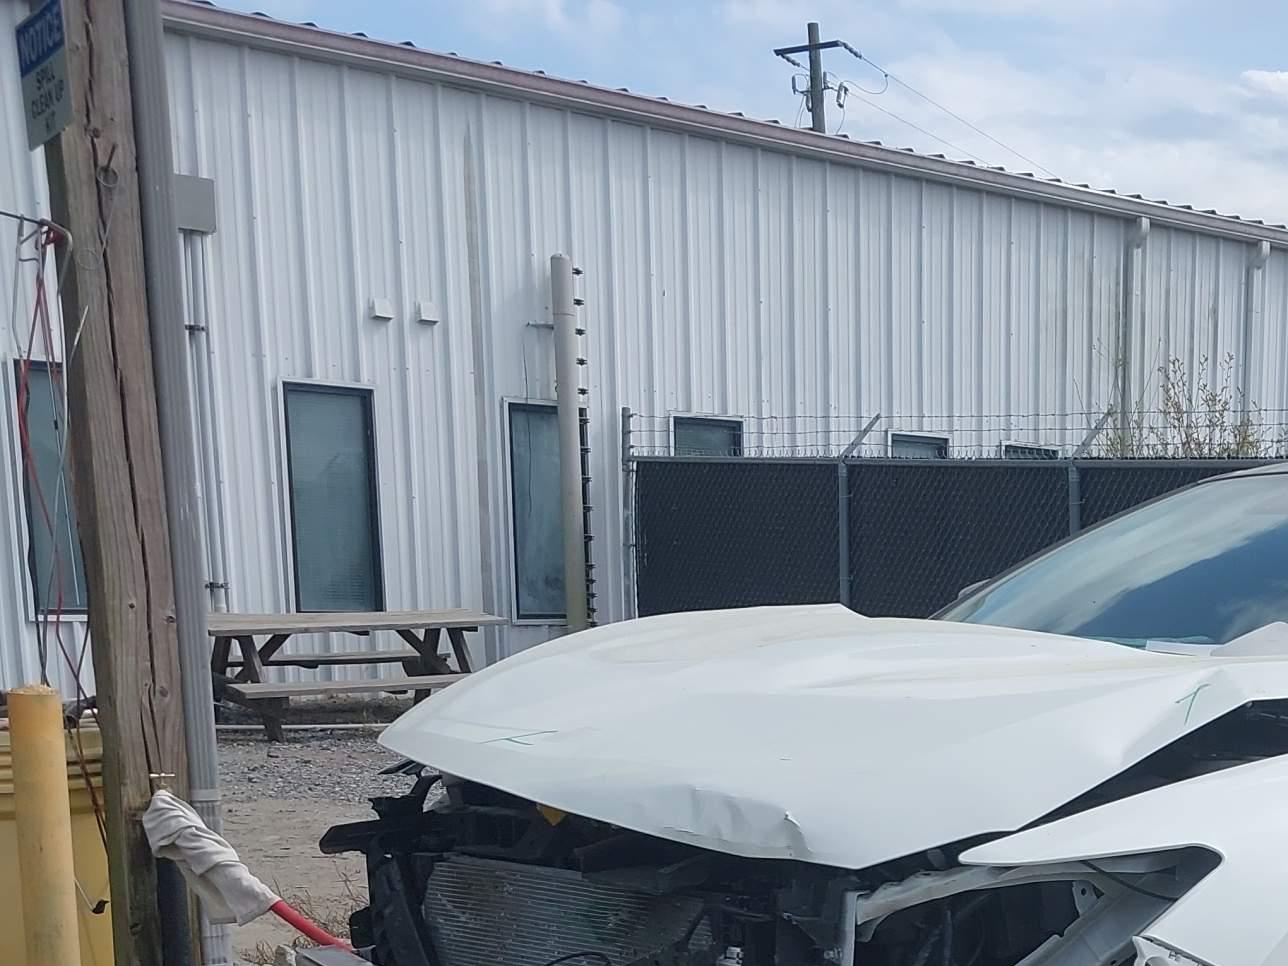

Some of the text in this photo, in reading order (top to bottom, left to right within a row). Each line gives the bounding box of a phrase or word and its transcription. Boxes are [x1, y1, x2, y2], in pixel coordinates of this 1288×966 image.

[20, 9, 61, 66] NOTICE
[31, 79, 65, 119] CLEAN UP
